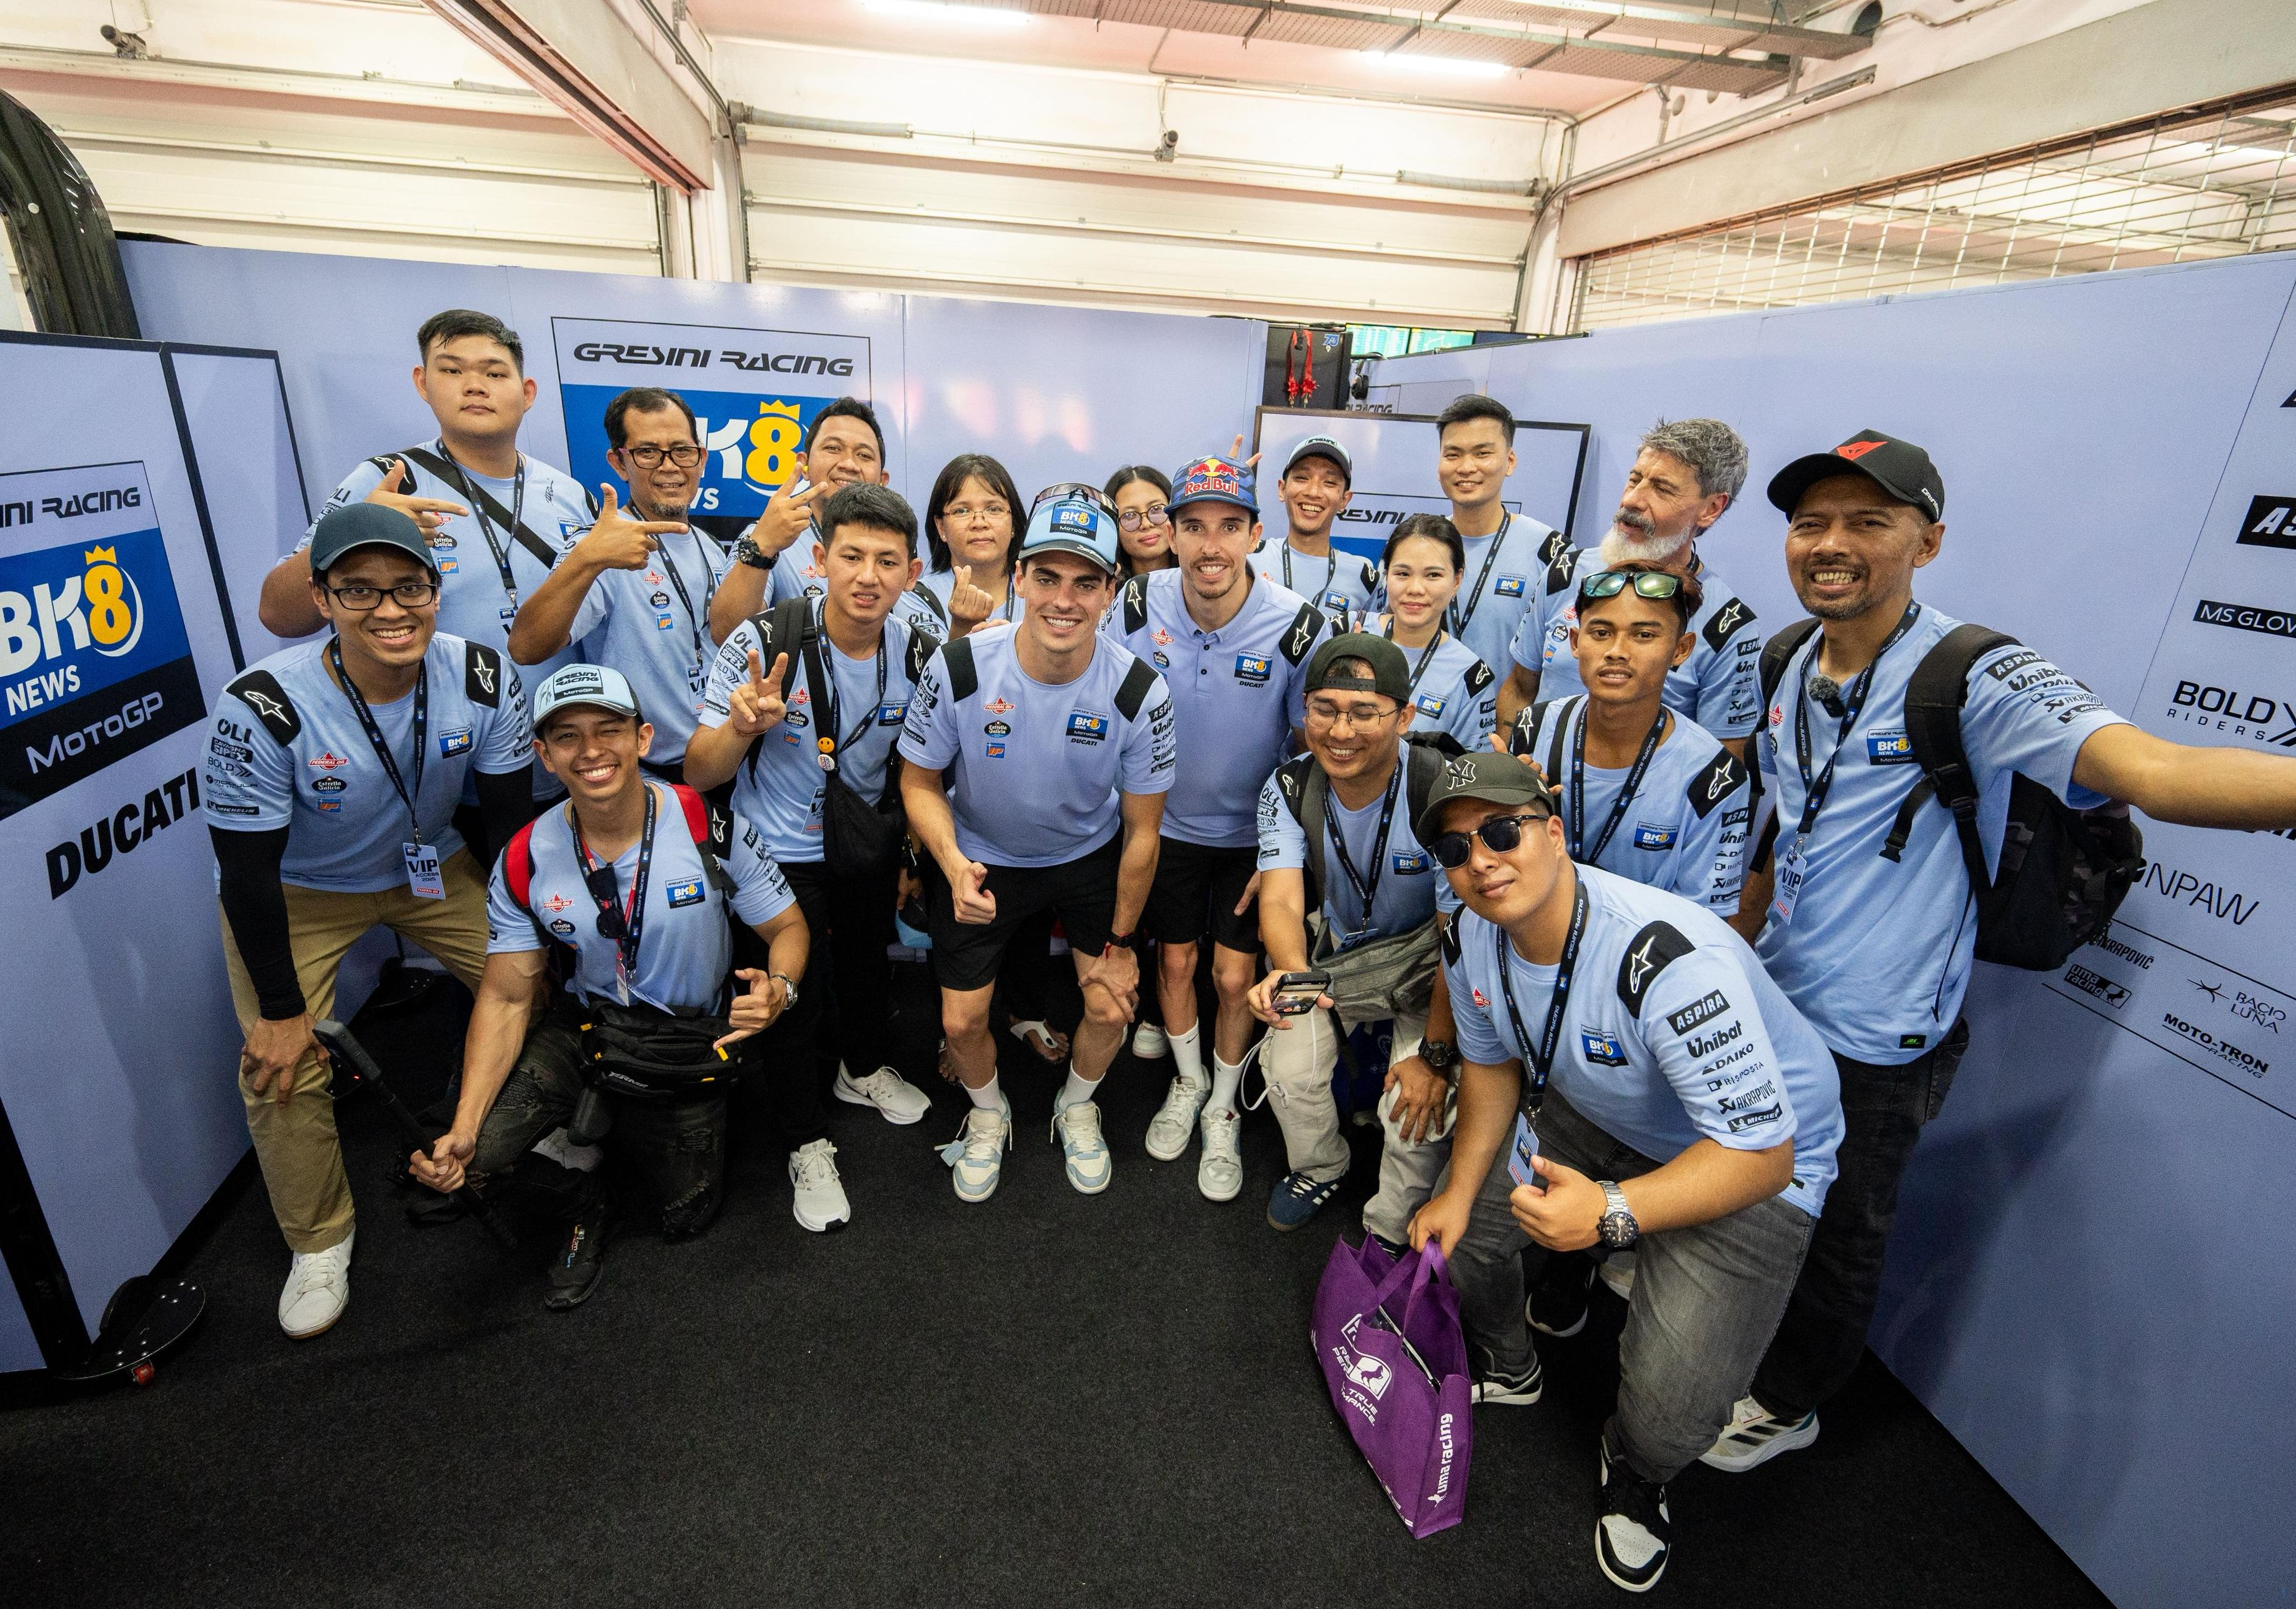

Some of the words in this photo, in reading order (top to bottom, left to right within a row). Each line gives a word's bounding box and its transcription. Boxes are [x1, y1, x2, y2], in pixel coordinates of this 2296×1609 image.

[574, 343, 711, 368] GRESINI
[720, 351, 853, 376] RACING
[1185, 477, 1211, 496] Red
[1213, 478, 1238, 496] Bull
[42, 487, 141, 518] RACING
[1061, 511, 1088, 524] BK8
[2200, 604, 2235, 623] MS
[721, 649, 744, 670] SIPEX
[725, 644, 746, 664] CAVAGNA
[1243, 658, 1265, 671] BK8
[556, 671, 598, 683] GRESINI
[556, 676, 599, 686] RACING
[923, 666, 940, 693] OLI
[6, 664, 80, 716] NEWS
[2172, 680, 2276, 724] BOLD
[218, 719, 252, 744] OLI
[1075, 717, 1100, 729] BK8
[2167, 708, 2267, 740] RIDERS
[214, 739, 246, 754] CAVAGNA
[448, 734, 468, 748] BK8
[1071, 738, 1097, 746] DUCATI
[1878, 739, 1908, 751] BK8
[208, 756, 234, 772] BOLD
[213, 745, 246, 761] SIPEX
[1631, 761, 1643, 787] GRESINI
[1642, 737, 1656, 762] RACING
[46, 767, 200, 900] DUCATI
[1605, 816, 1618, 838] RACING
[1643, 832, 1668, 843] BK8
[408, 860, 438, 873] VIP
[1782, 868, 1802, 888] VIP
[674, 884, 696, 897] BK8
[1568, 926, 1578, 960] GRESINI
[1575, 899, 1583, 925] RACING
[2067, 973, 2103, 996] racing
[2071, 965, 2100, 984] uma
[2236, 991, 2287, 1021] BACIO
[2231, 1003, 2278, 1034] LUNA
[1516, 1024, 1528, 1051] GRESINI
[1544, 1030, 1554, 1059] GRESINI
[1551, 1005, 1560, 1030] RACING
[1687, 1020, 1743, 1058] Unibat
[2164, 1013, 2269, 1073] MOTO-TRON
[1715, 1043, 1754, 1070] DAIKO
[2208, 1048, 2263, 1079] RACING
[1724, 1061, 1764, 1086] RISPOSTA
[1349, 1388, 1378, 1415] TRUE
